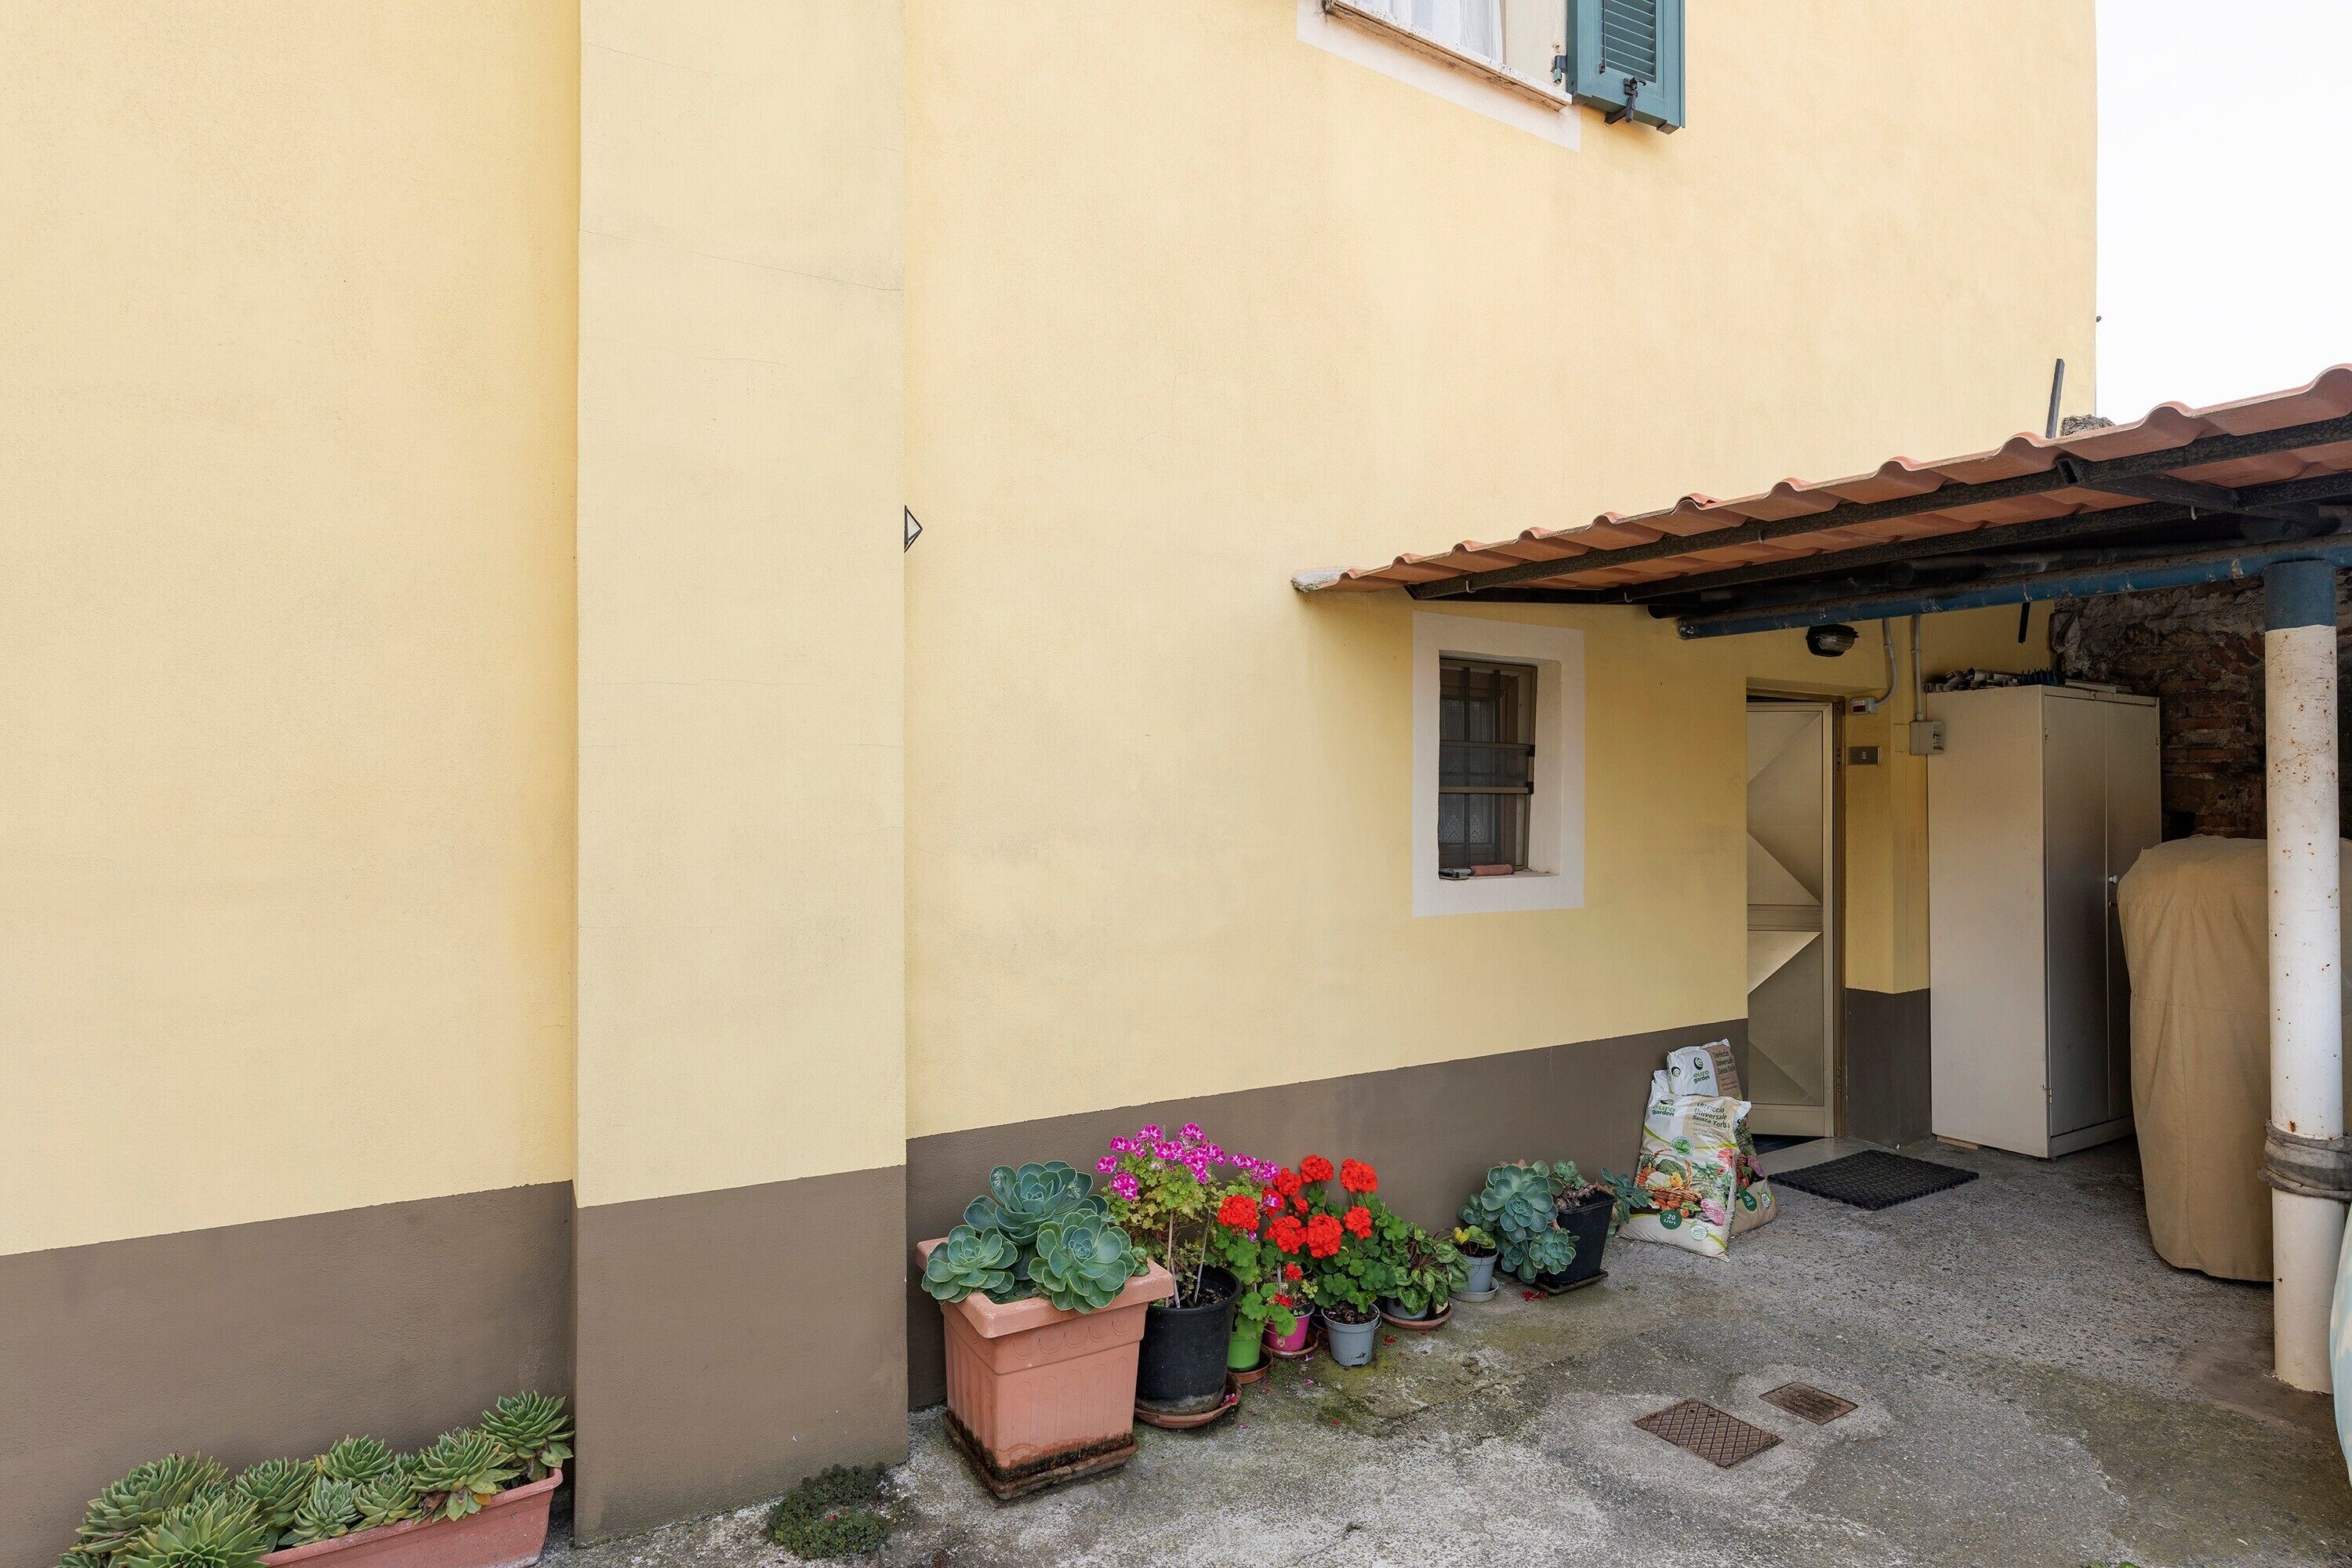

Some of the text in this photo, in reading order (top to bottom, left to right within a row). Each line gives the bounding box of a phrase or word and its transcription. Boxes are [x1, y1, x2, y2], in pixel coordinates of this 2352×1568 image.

[1693, 1075, 1711, 1084] garden
[1694, 1107, 1727, 1120] Universale
[1692, 1115, 1711, 1123] Senza
